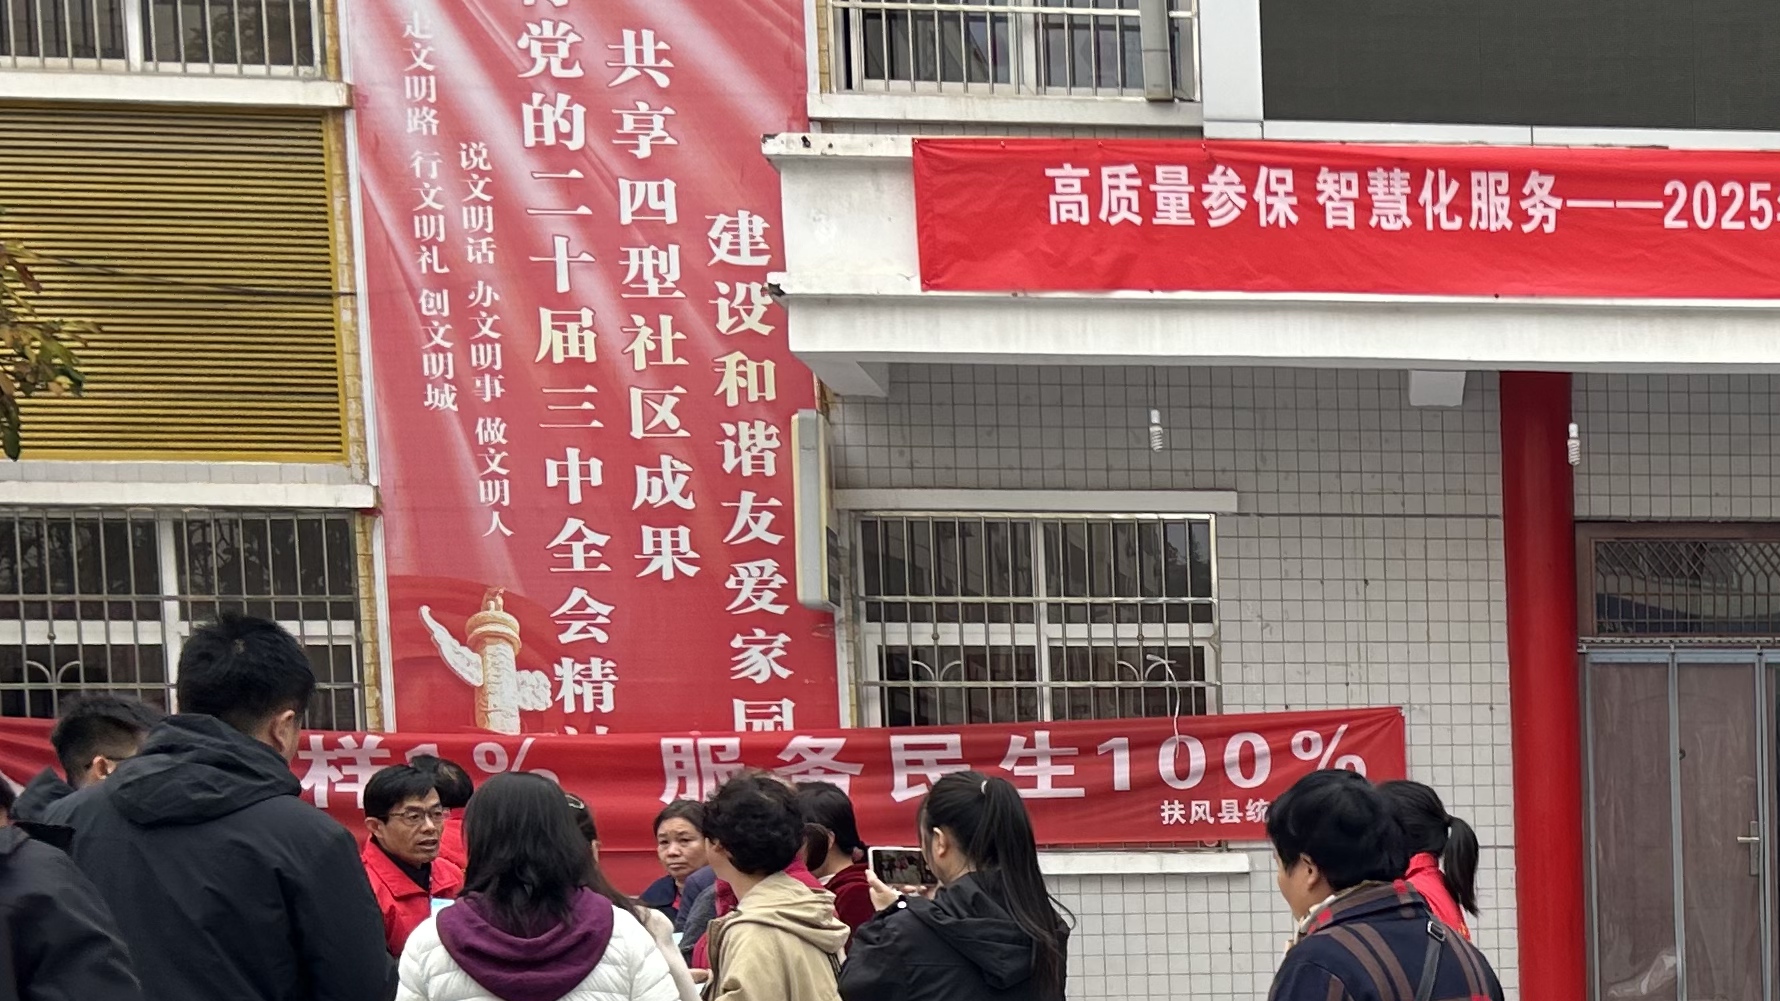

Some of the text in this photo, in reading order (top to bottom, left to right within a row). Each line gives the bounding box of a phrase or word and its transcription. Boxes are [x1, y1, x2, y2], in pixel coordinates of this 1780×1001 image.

[410, 150, 450, 274] 行文明礼
[1044, 164, 1299, 227] 高质量参保
[418, 288, 458, 412] 创文明城
[459, 142, 514, 538] 说文明话 办文明事 做文明人
[606, 29, 701, 581] 共享四型社区成果
[517, 0, 619, 735] 党的二十届三中全会精
[298, 733, 561, 809] 样%
[1161, 798, 1271, 825] 扶风县统
